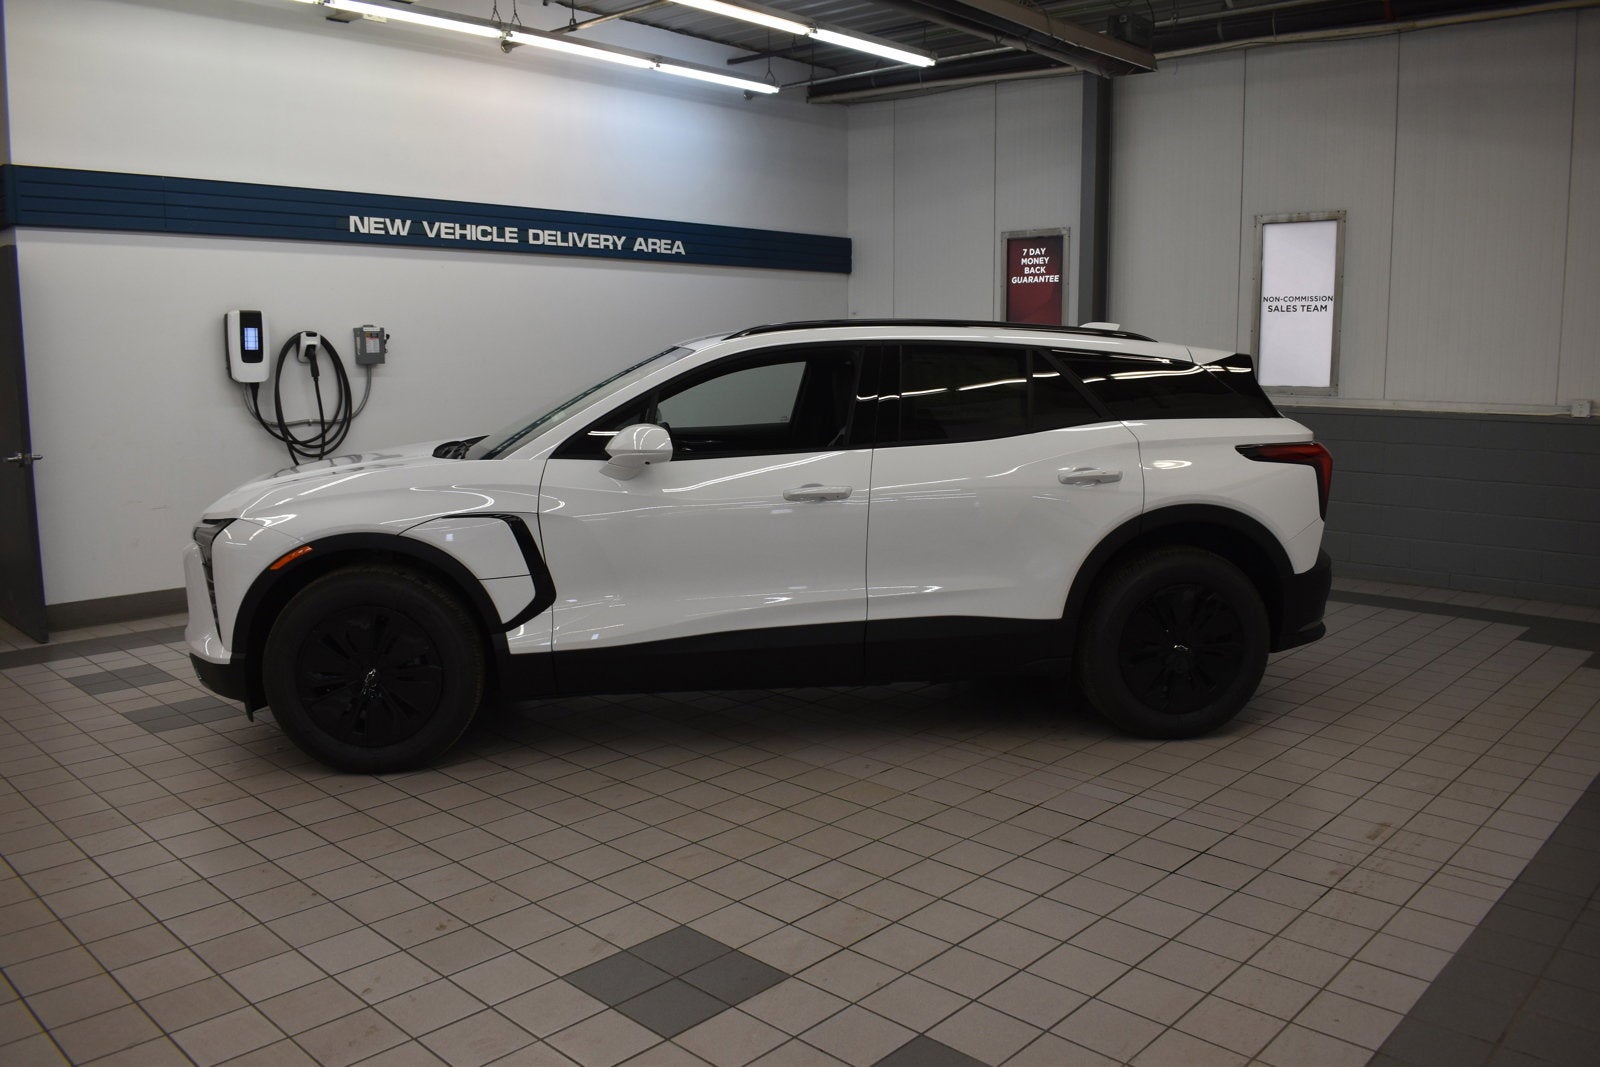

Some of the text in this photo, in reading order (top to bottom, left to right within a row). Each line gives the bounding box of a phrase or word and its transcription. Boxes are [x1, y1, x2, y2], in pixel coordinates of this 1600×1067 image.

[350, 215, 686, 255] NEW VEHICLE DELIVERY AREA
[1022, 247, 1046, 256] 7 DAY
[1021, 257, 1050, 265] MONEY
[1024, 266, 1046, 274] BACK
[1011, 275, 1060, 284] GUARANTEE
[1263, 295, 1333, 303] NON-COMMISSION
[1267, 305, 1328, 313] SALES TEAM
